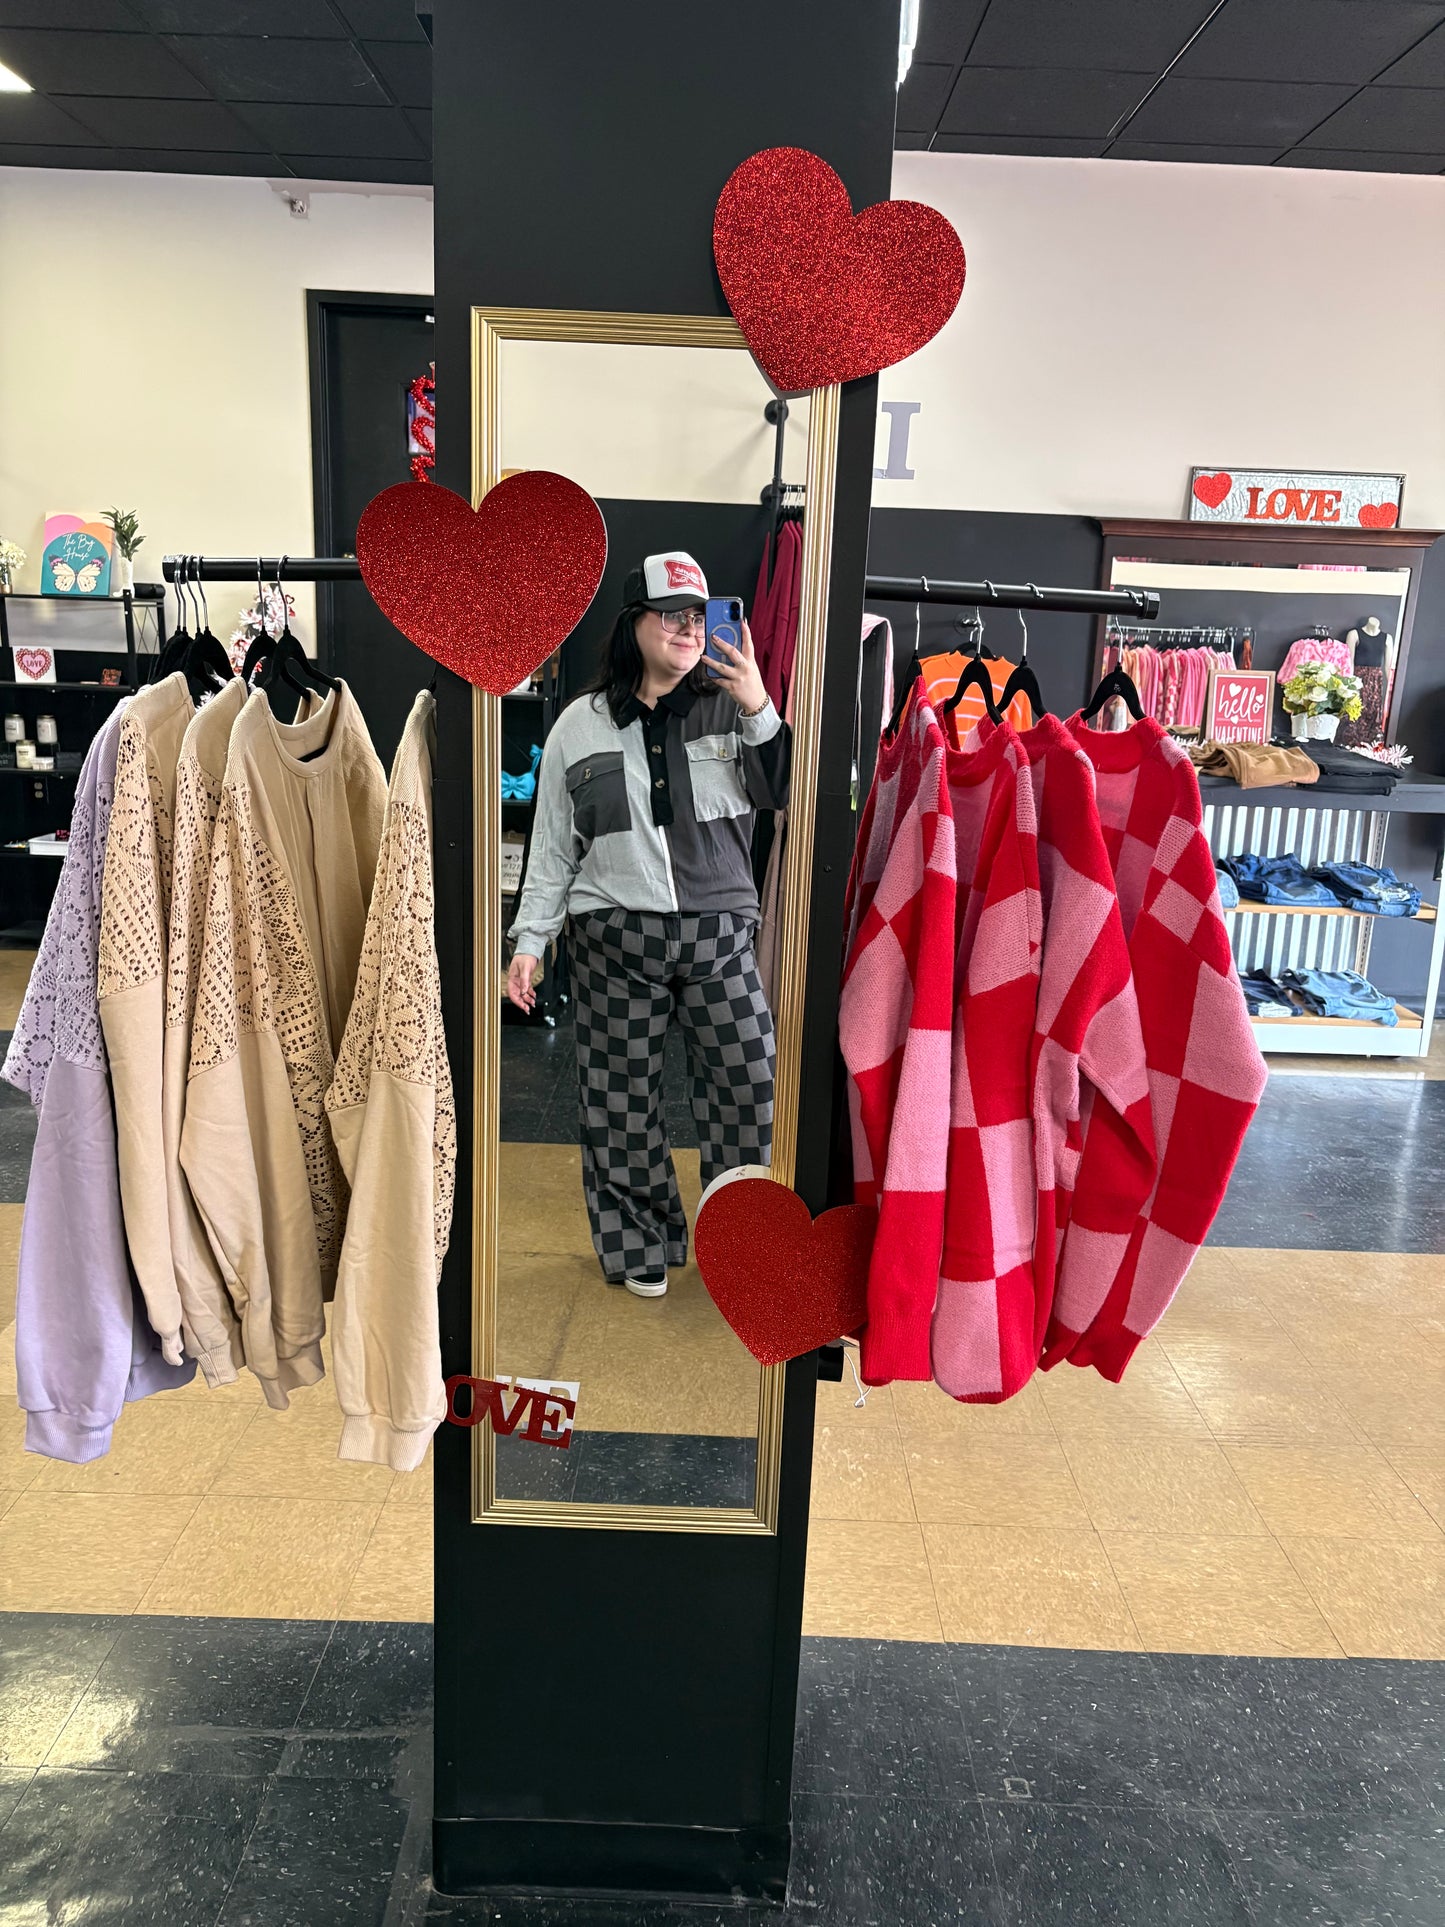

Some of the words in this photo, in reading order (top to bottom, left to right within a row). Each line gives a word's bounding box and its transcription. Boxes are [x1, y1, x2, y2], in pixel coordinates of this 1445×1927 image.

[1243, 486, 1343, 522] LOVE
[62, 533, 76, 550] The
[63, 547, 89, 562] House
[26, 659, 43, 668] LOVE
[1218, 684, 1265, 723] hello
[1215, 725, 1263, 744] VALENTINE
[445, 1374, 577, 1449] OVE
